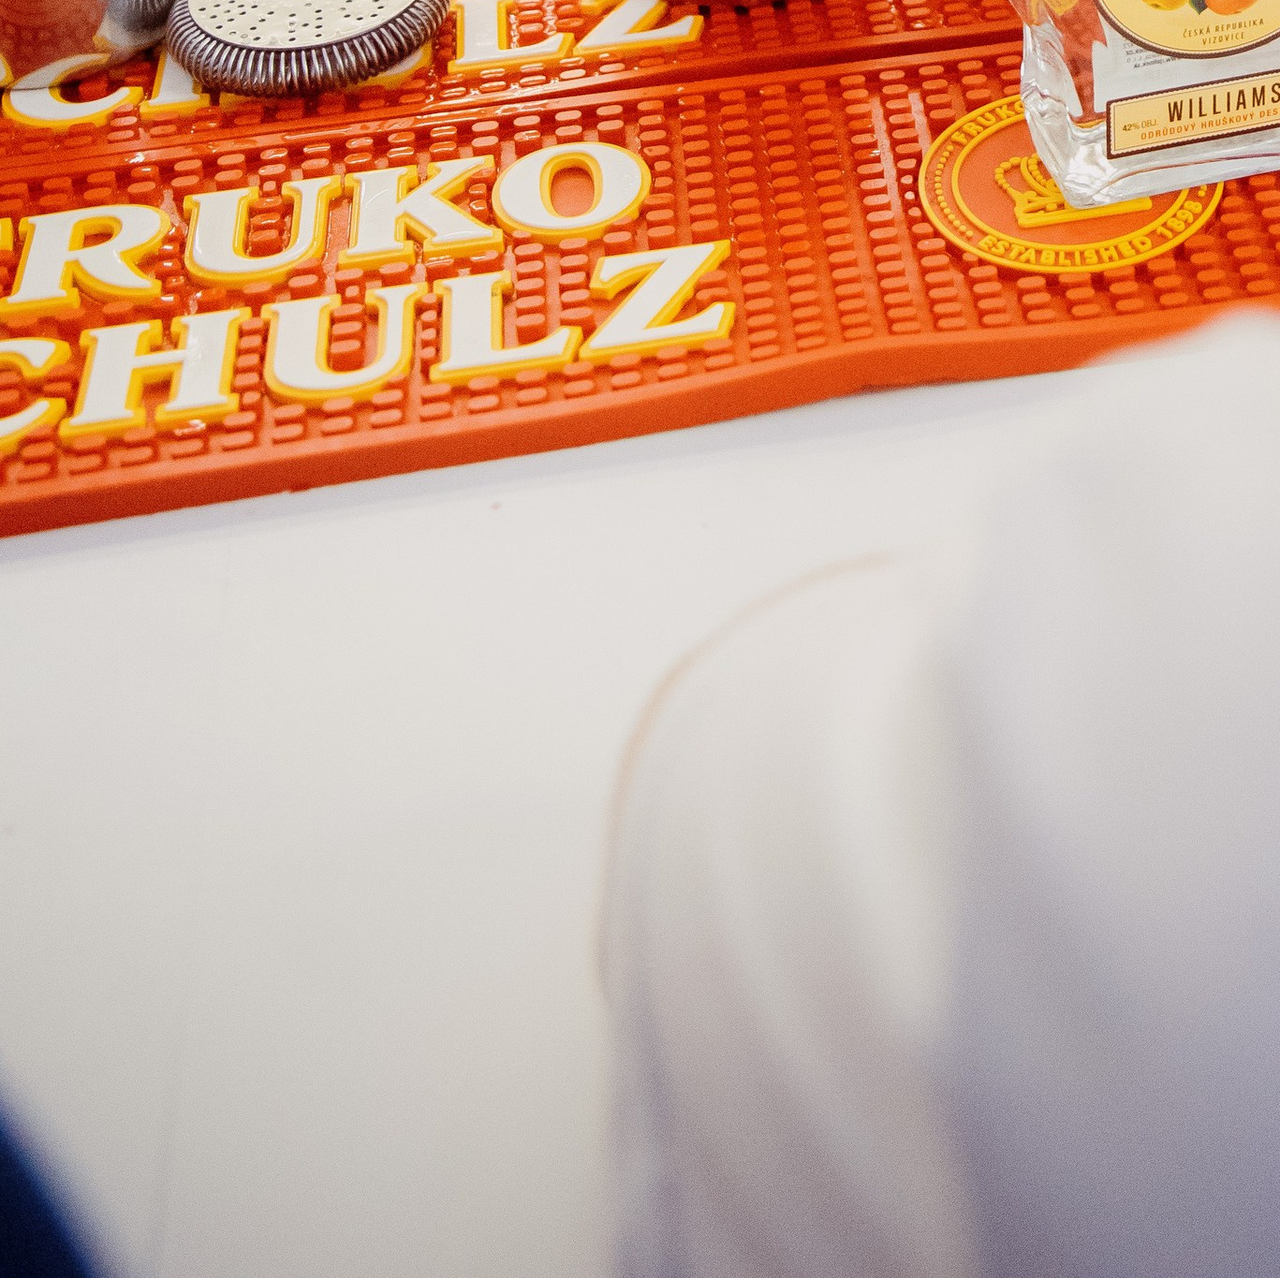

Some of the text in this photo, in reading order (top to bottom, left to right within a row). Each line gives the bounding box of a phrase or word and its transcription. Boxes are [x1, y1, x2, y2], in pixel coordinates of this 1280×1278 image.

[1182, 18, 1265, 39] ČESKÁ REPUBLIKA
[1202, 31, 1245, 45] VIZOVICE
[0, 141, 653, 315] RUKO
[977, 198, 1204, 268] ESTABLISHED 1898
[0, 240, 736, 457] CHULZ
